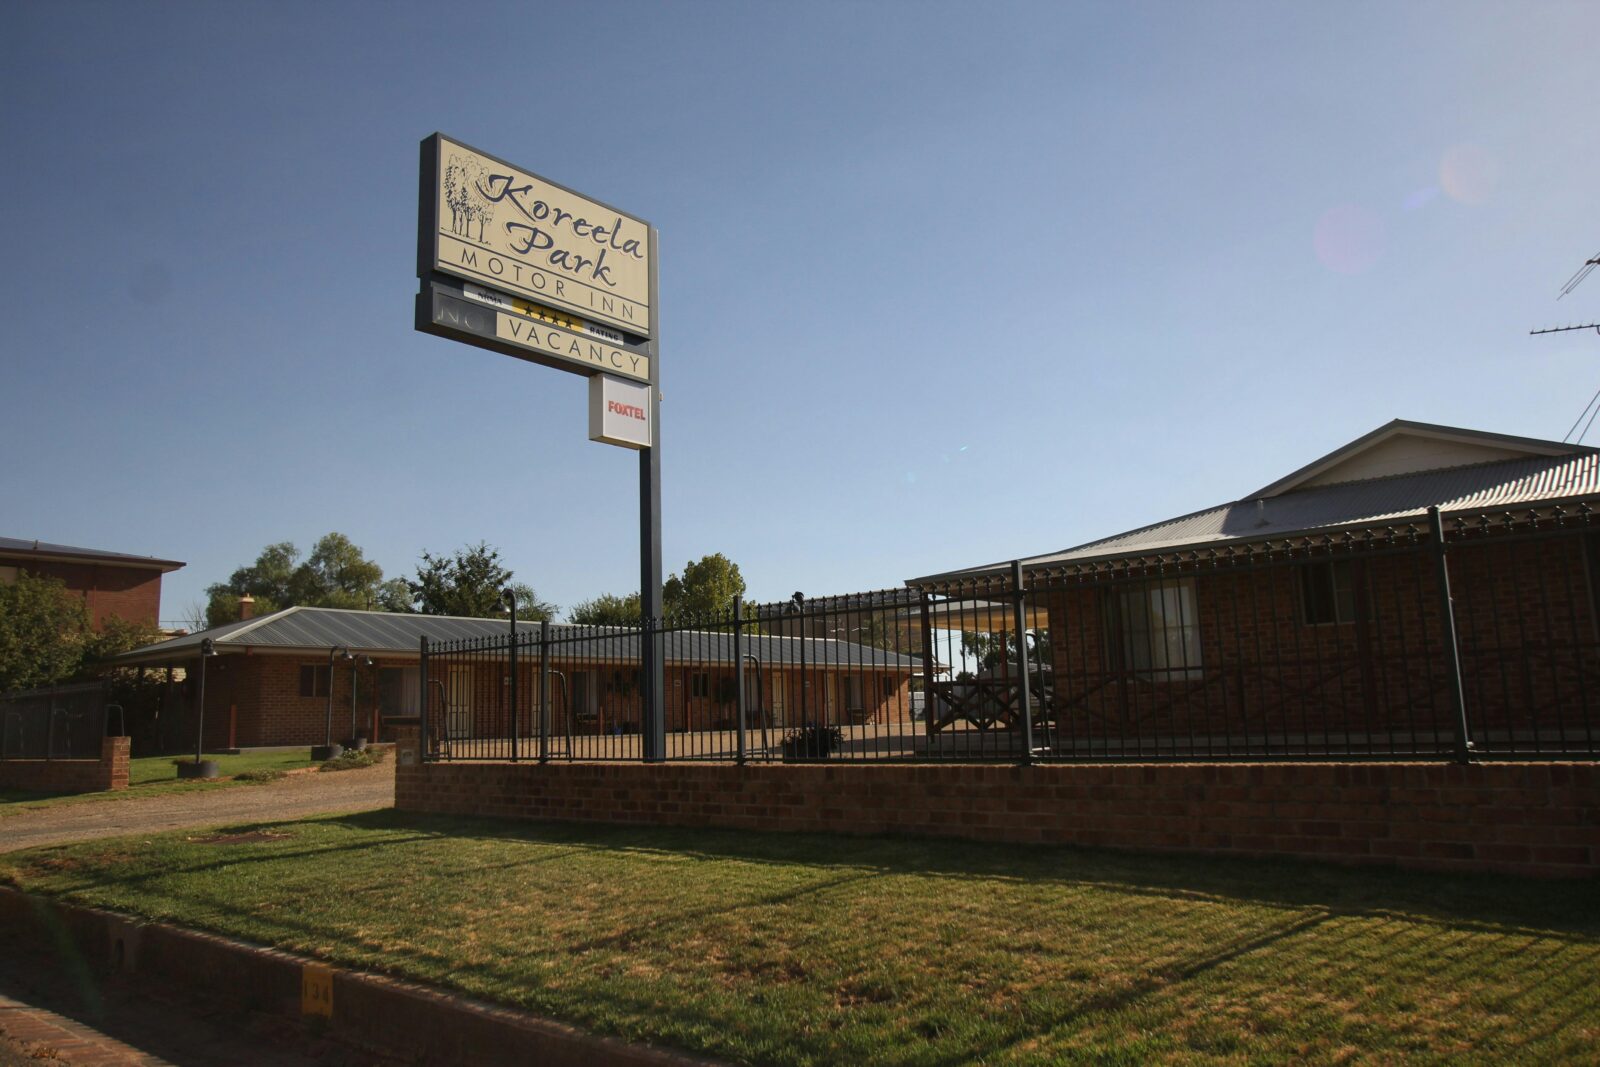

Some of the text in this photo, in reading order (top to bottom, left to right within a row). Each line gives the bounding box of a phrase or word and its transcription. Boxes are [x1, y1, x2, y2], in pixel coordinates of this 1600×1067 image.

[475, 173, 644, 259] Koreela
[461, 248, 634, 320] MOTOR INN
[506, 221, 616, 287] Park
[437, 306, 641, 373] NO VACANCY
[589, 326, 619, 341] RATING
[607, 399, 646, 421] FOXTEL
